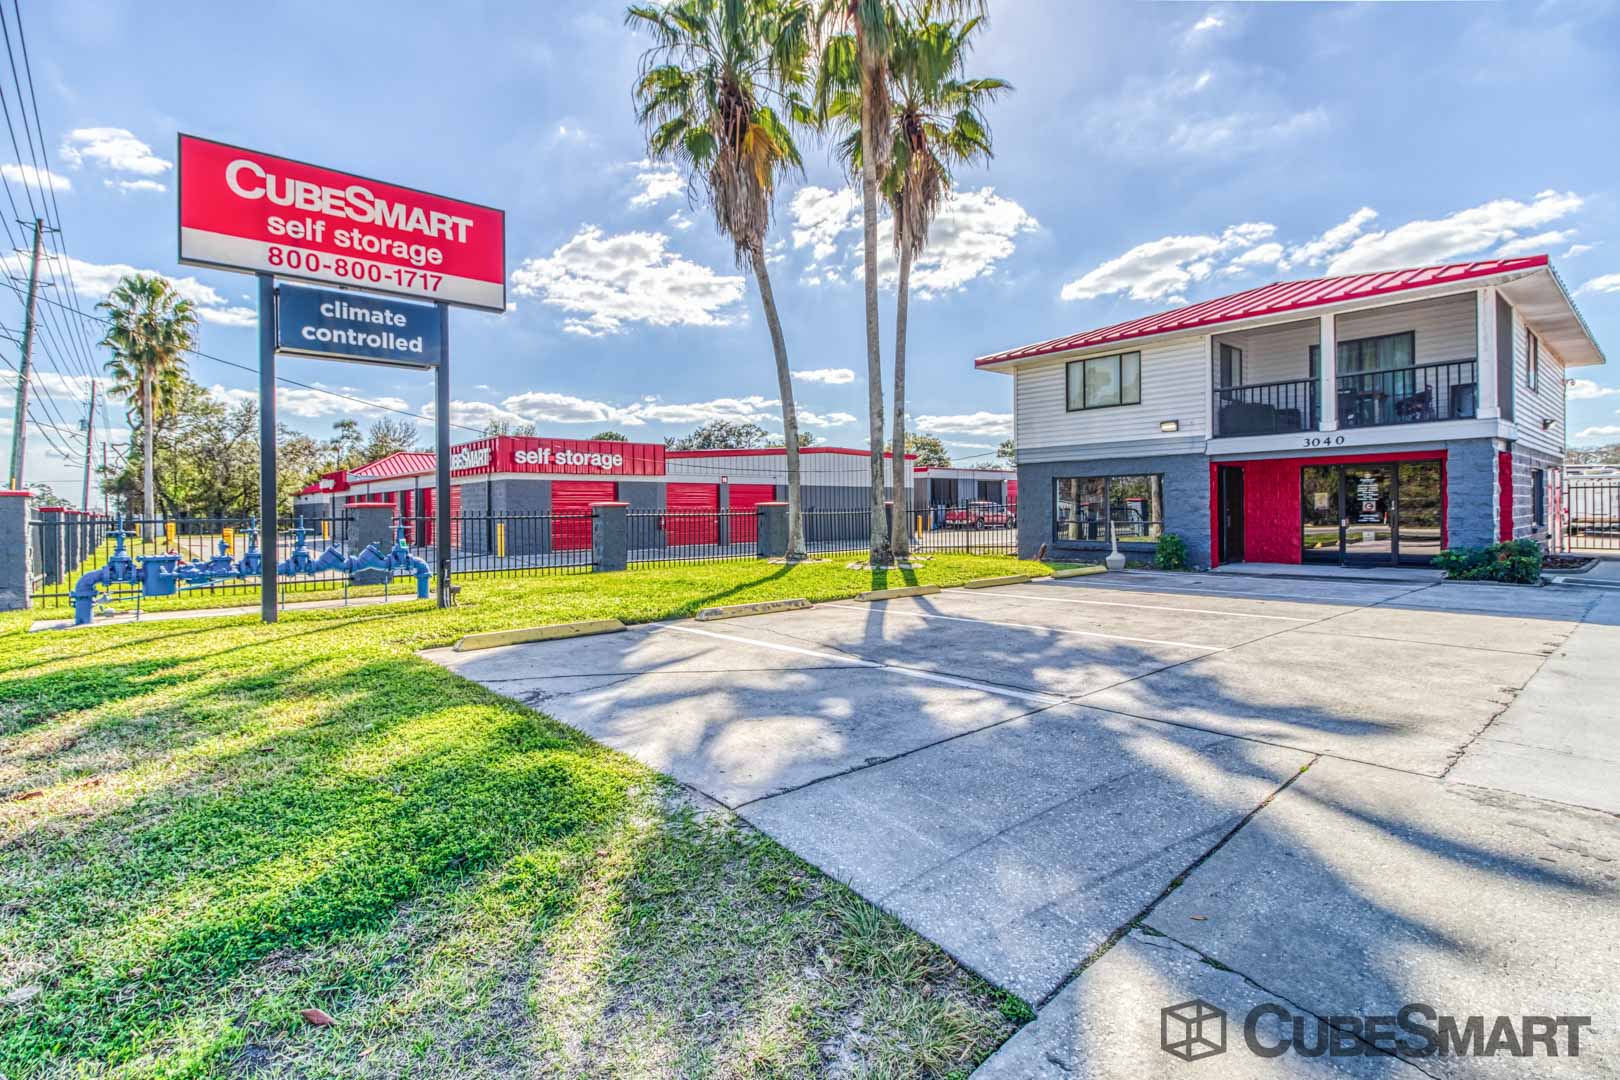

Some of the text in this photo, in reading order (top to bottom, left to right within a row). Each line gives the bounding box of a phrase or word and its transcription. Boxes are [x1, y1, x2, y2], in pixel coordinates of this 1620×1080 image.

[225, 159, 473, 243] CUBESMART
[267, 215, 443, 266] self storage
[268, 246, 442, 292] 800-800-1717
[320, 301, 407, 328] climate
[301, 323, 423, 353] controlled
[1303, 436, 1345, 447] 3040
[514, 448, 623, 469] self storage
